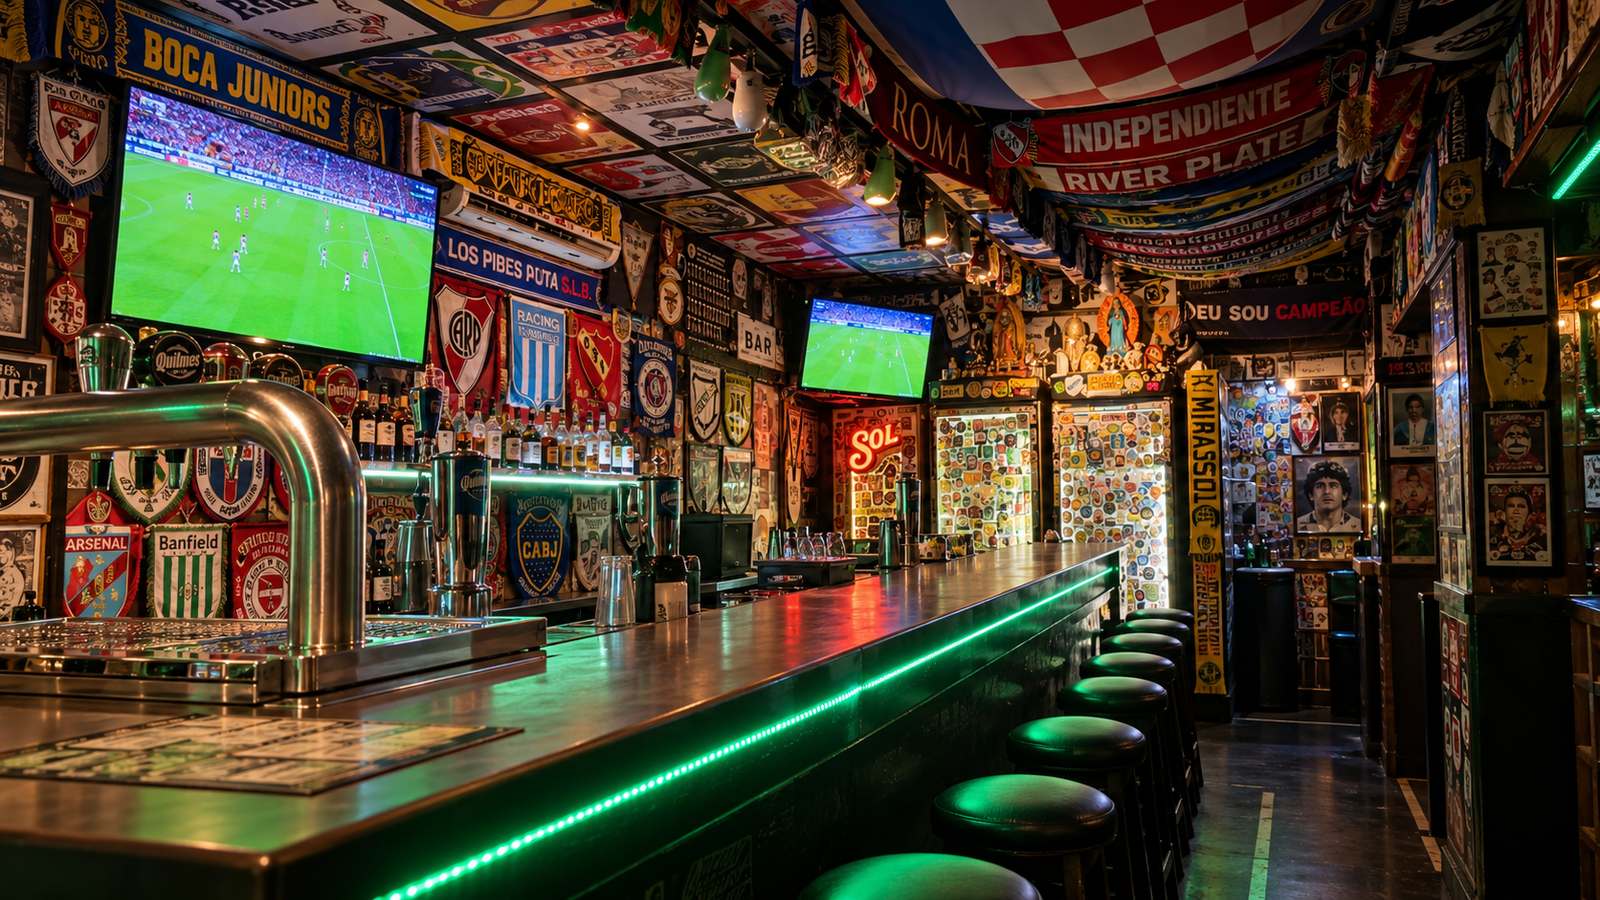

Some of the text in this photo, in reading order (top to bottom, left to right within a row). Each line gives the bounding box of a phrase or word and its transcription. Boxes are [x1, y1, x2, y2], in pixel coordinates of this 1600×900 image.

[144, 28, 331, 130] BOCA JUNIORS
[892, 81, 971, 175] ROMA
[1062, 78, 1292, 153] INDEPENDIENTE
[1064, 124, 1300, 191] RIVER PLATE
[448, 238, 479, 265] LOS
[483, 249, 523, 279] PIBES
[561, 276, 592, 300] S.L.B.
[517, 309, 560, 331] RACING
[1229, 305, 1269, 321] SOU
[1275, 296, 1366, 320] CAMPEÃO
[745, 330, 772, 356] BAR
[156, 352, 200, 372] Quilmes
[849, 424, 899, 470] SOL
[65, 537, 128, 551] ARSENAL
[159, 534, 218, 550] Banfield
[522, 541, 558, 559] CABJ
